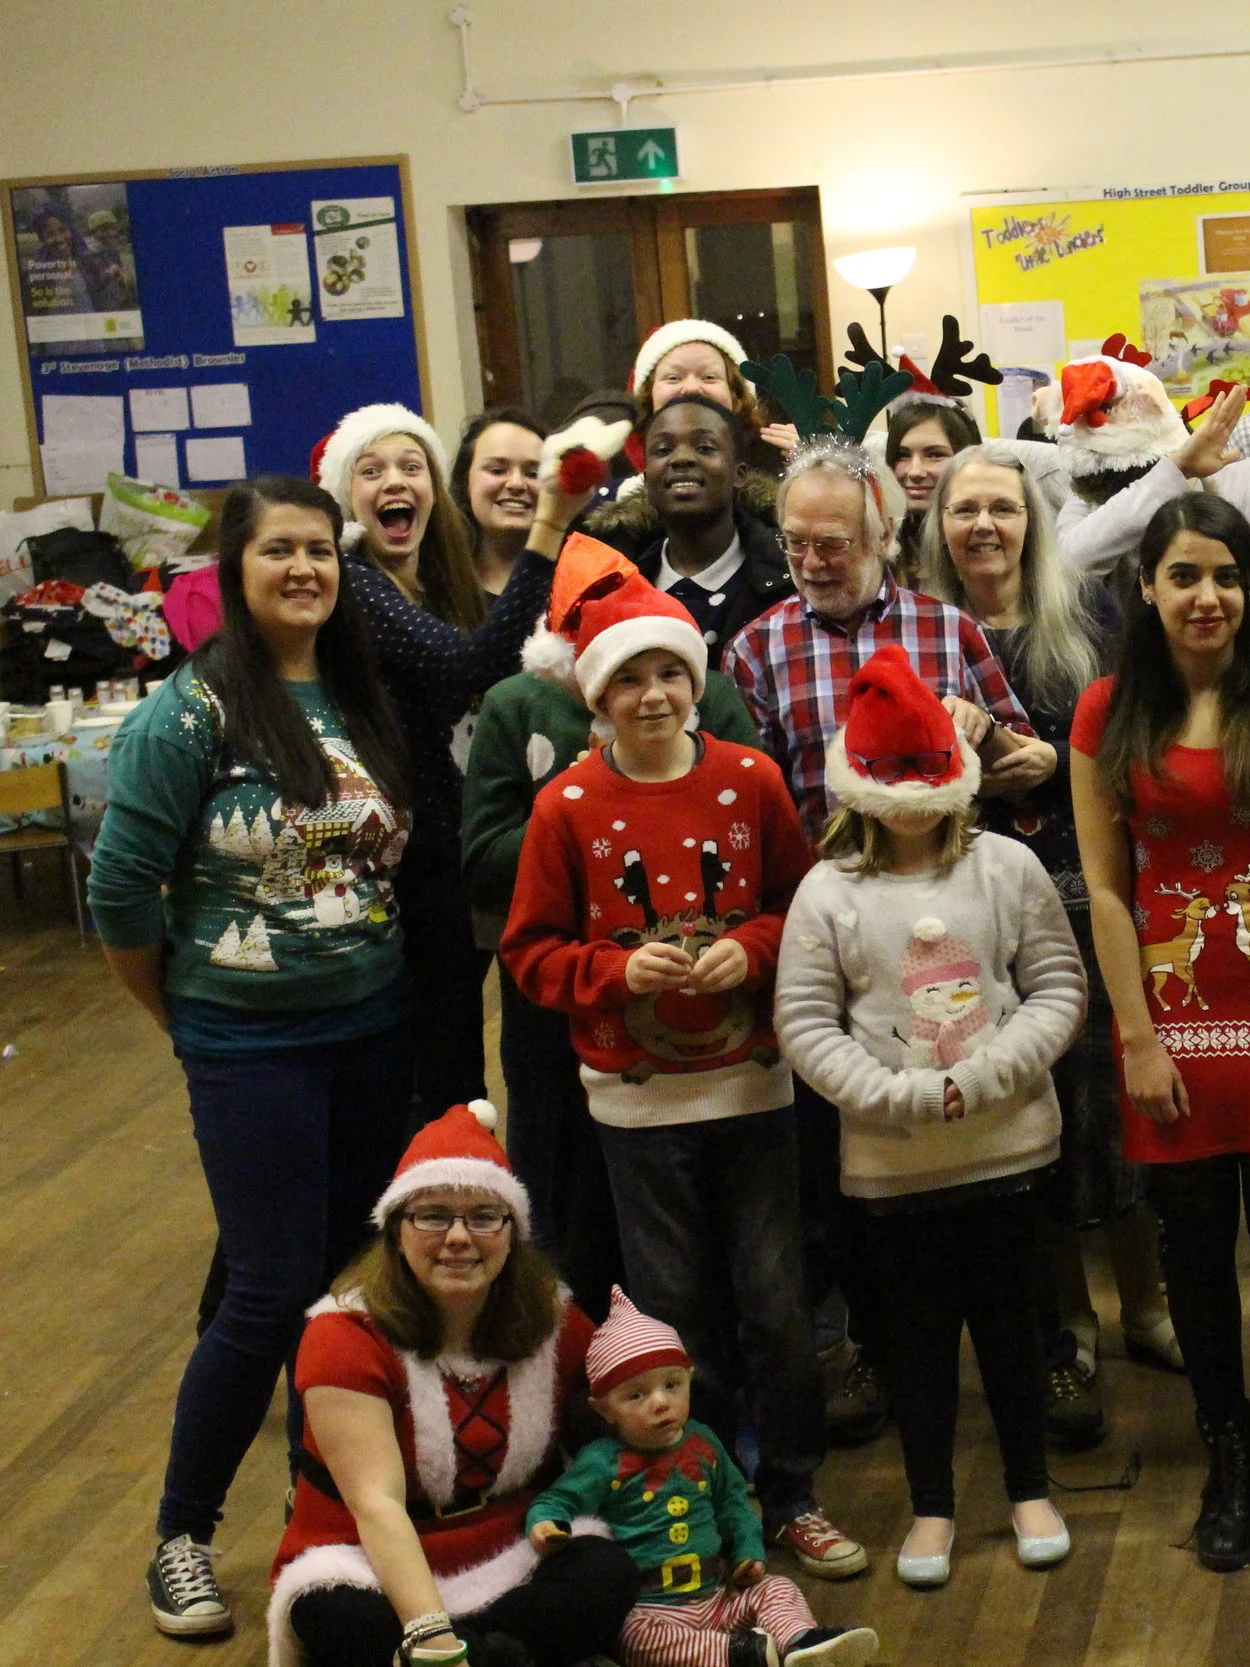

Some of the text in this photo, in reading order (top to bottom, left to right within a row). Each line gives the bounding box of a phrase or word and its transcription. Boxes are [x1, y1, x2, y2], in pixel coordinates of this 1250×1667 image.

[203, 165, 239, 176] Action
[1103, 188, 1131, 199] High
[1134, 187, 1167, 198] Street
[1170, 184, 1214, 196] Toddler
[28, 259, 69, 271] Poverty
